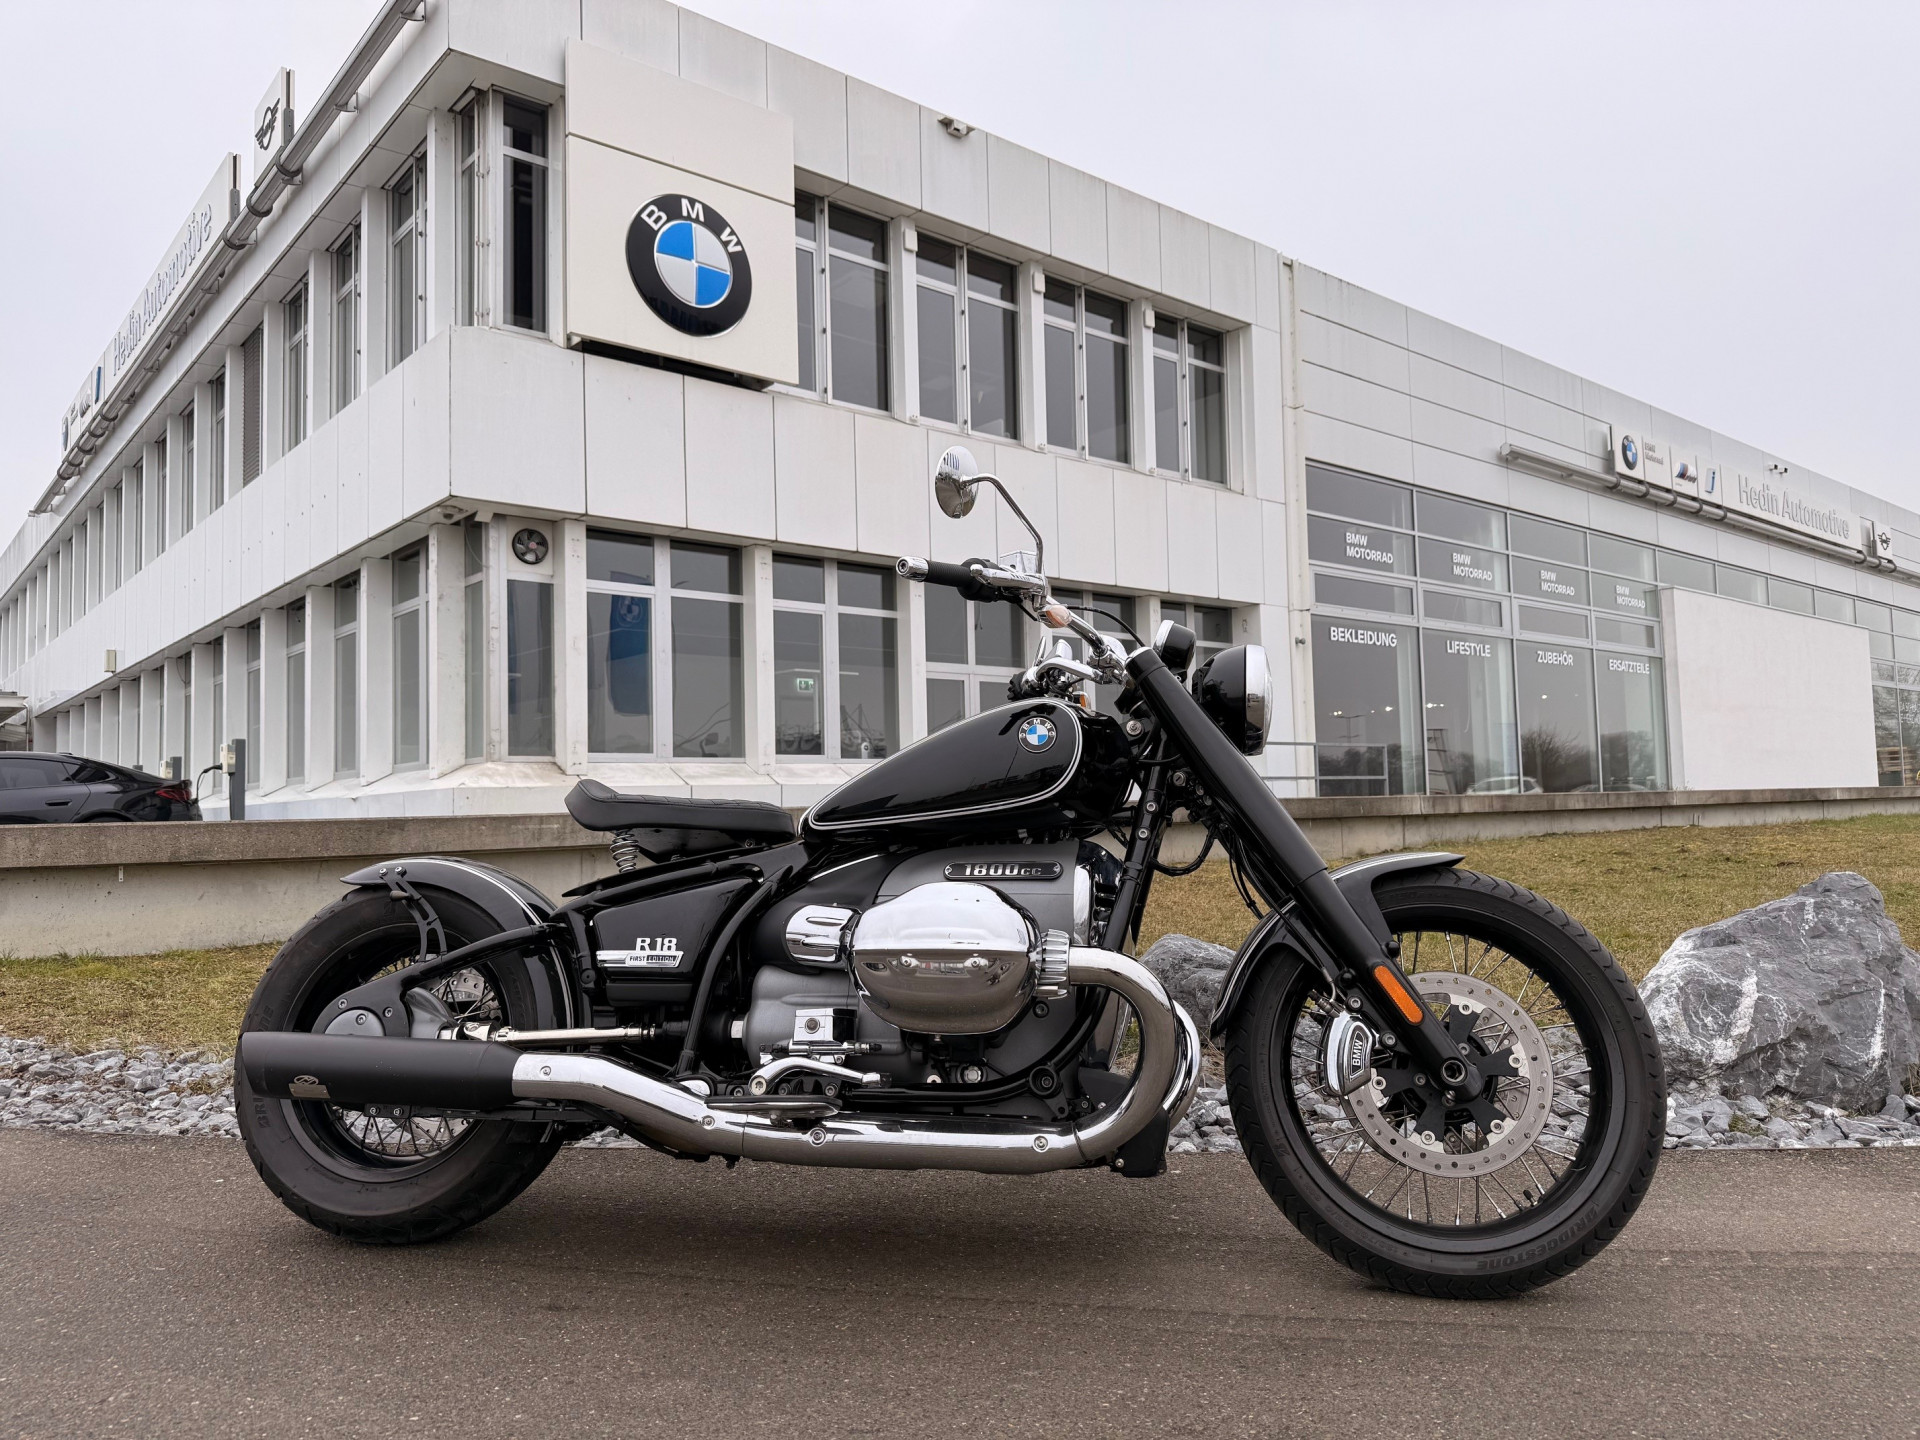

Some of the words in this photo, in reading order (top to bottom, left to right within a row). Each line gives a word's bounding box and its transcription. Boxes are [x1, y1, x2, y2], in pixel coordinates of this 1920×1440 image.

[640, 197, 743, 253] BMW
[142, 203, 212, 337] Automotive
[1738, 474, 1780, 517] Hedin
[1781, 488, 1851, 541] Automotive
[1346, 532, 1368, 547] BMW
[1346, 546, 1394, 564] MOTORRAD
[1452, 553, 1471, 565] BMW
[1453, 565, 1493, 581] MOTORRAD
[1540, 570, 1557, 581] BMW
[1541, 581, 1575, 596] MOTORRAD
[1616, 584, 1630, 595] BMW
[1616, 595, 1646, 609] MOTORRAD
[1330, 626, 1398, 648] BEKLEIDUNG
[1446, 640, 1491, 657] LIFESTYLE
[1537, 650, 1574, 667] ZUBEHÖR
[1609, 659, 1650, 675] ERSATZTEILE
[1022, 718, 1052, 731] BMW
[964, 863, 1042, 876] 1800cc
[1352, 1039, 1363, 1066] BMW
[1476, 1206, 1598, 1272] BRIDGESTONE
